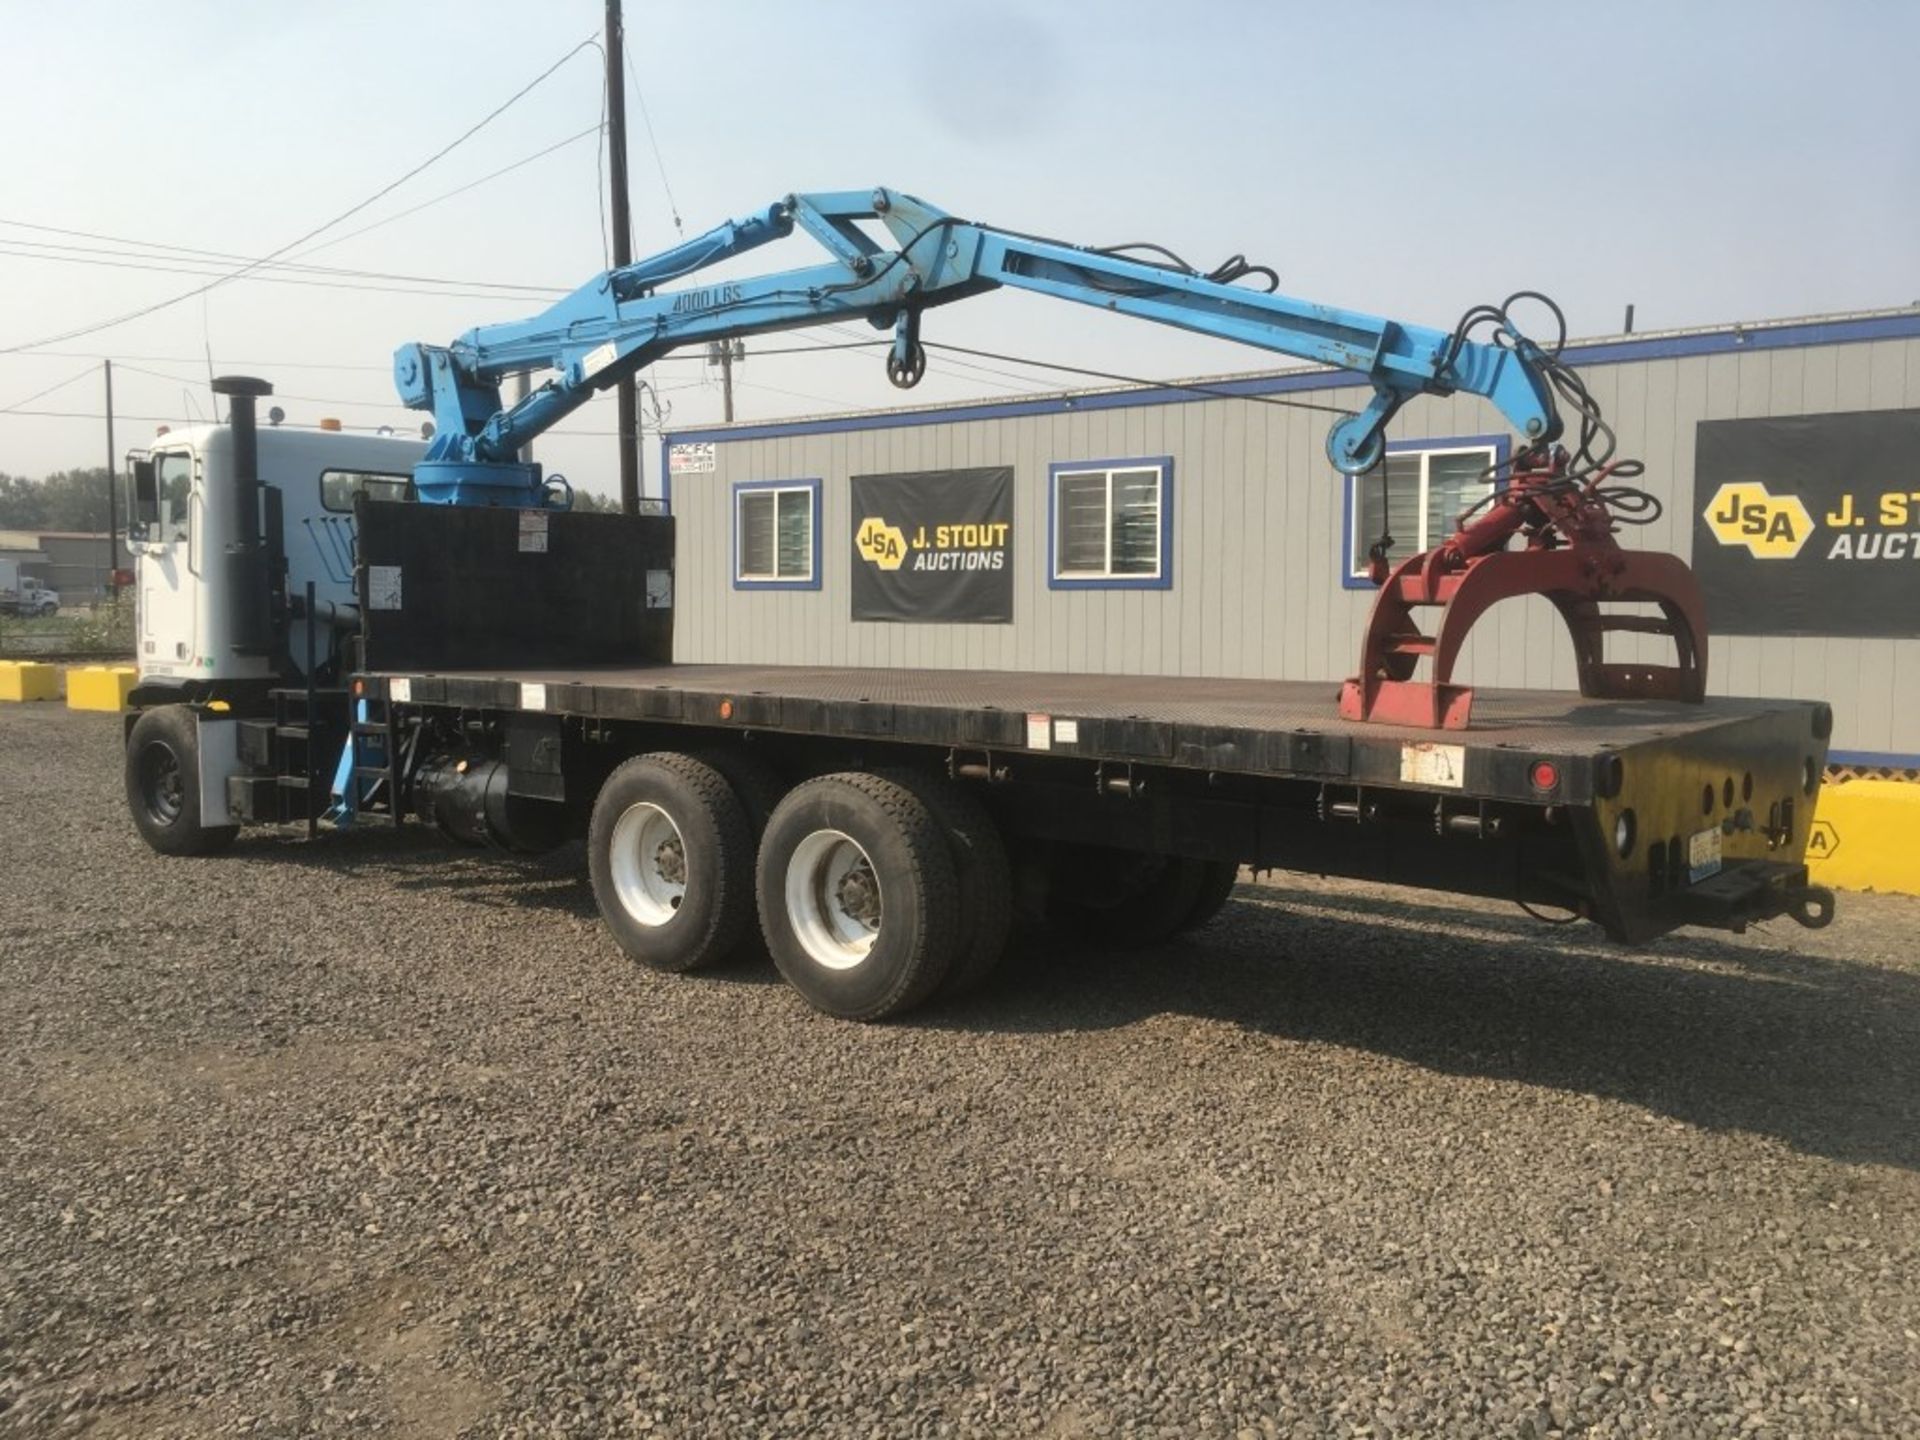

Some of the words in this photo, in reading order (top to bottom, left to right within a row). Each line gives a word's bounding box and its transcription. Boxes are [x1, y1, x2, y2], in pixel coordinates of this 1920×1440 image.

[672, 289, 710, 313] 4000
[1716, 494, 1796, 543] JSA
[1826, 494, 1865, 527] J.
[861, 525, 899, 559] JSA
[912, 526, 931, 549] J.
[936, 524, 1009, 548] STOUT
[913, 551, 1004, 571] AUCTIONS
